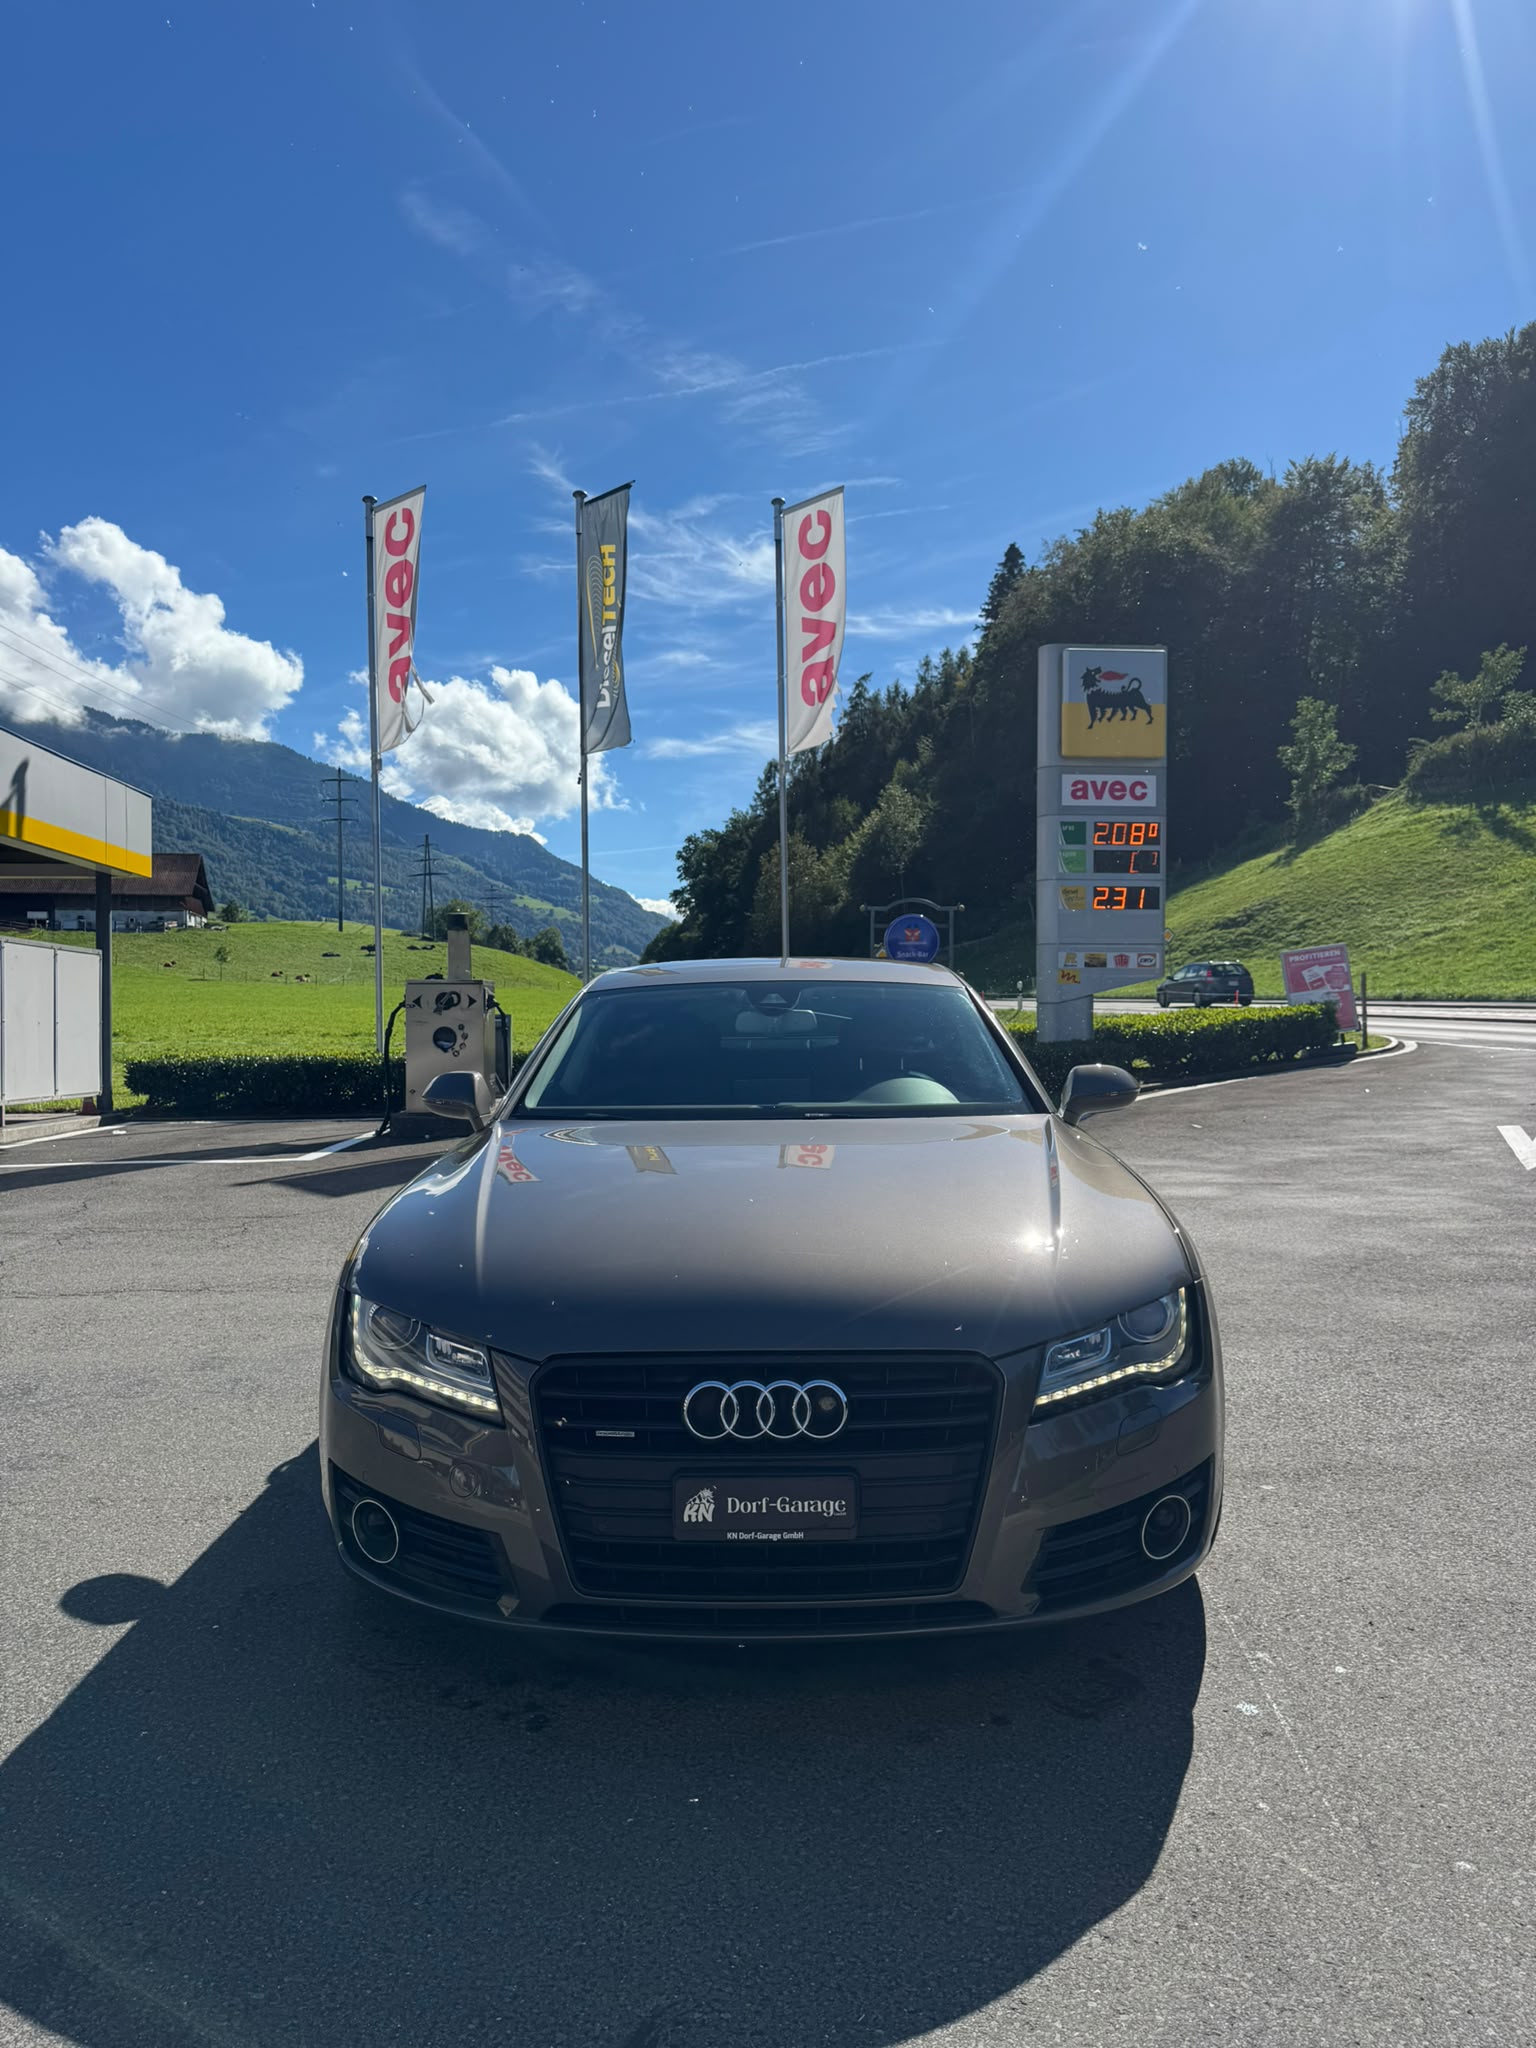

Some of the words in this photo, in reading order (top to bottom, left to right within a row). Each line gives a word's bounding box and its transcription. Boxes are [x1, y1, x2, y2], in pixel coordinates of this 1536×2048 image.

[384, 507, 415, 703] avec
[798, 509, 836, 707] avec
[1070, 779, 1148, 801] avec
[683, 1503, 715, 1523] KN
[727, 1496, 847, 1517] Dorf-Garage
[727, 1532, 738, 1540] KN
[738, 1532, 782, 1541] Dorf-Garage
[782, 1532, 804, 1540] GmbH
